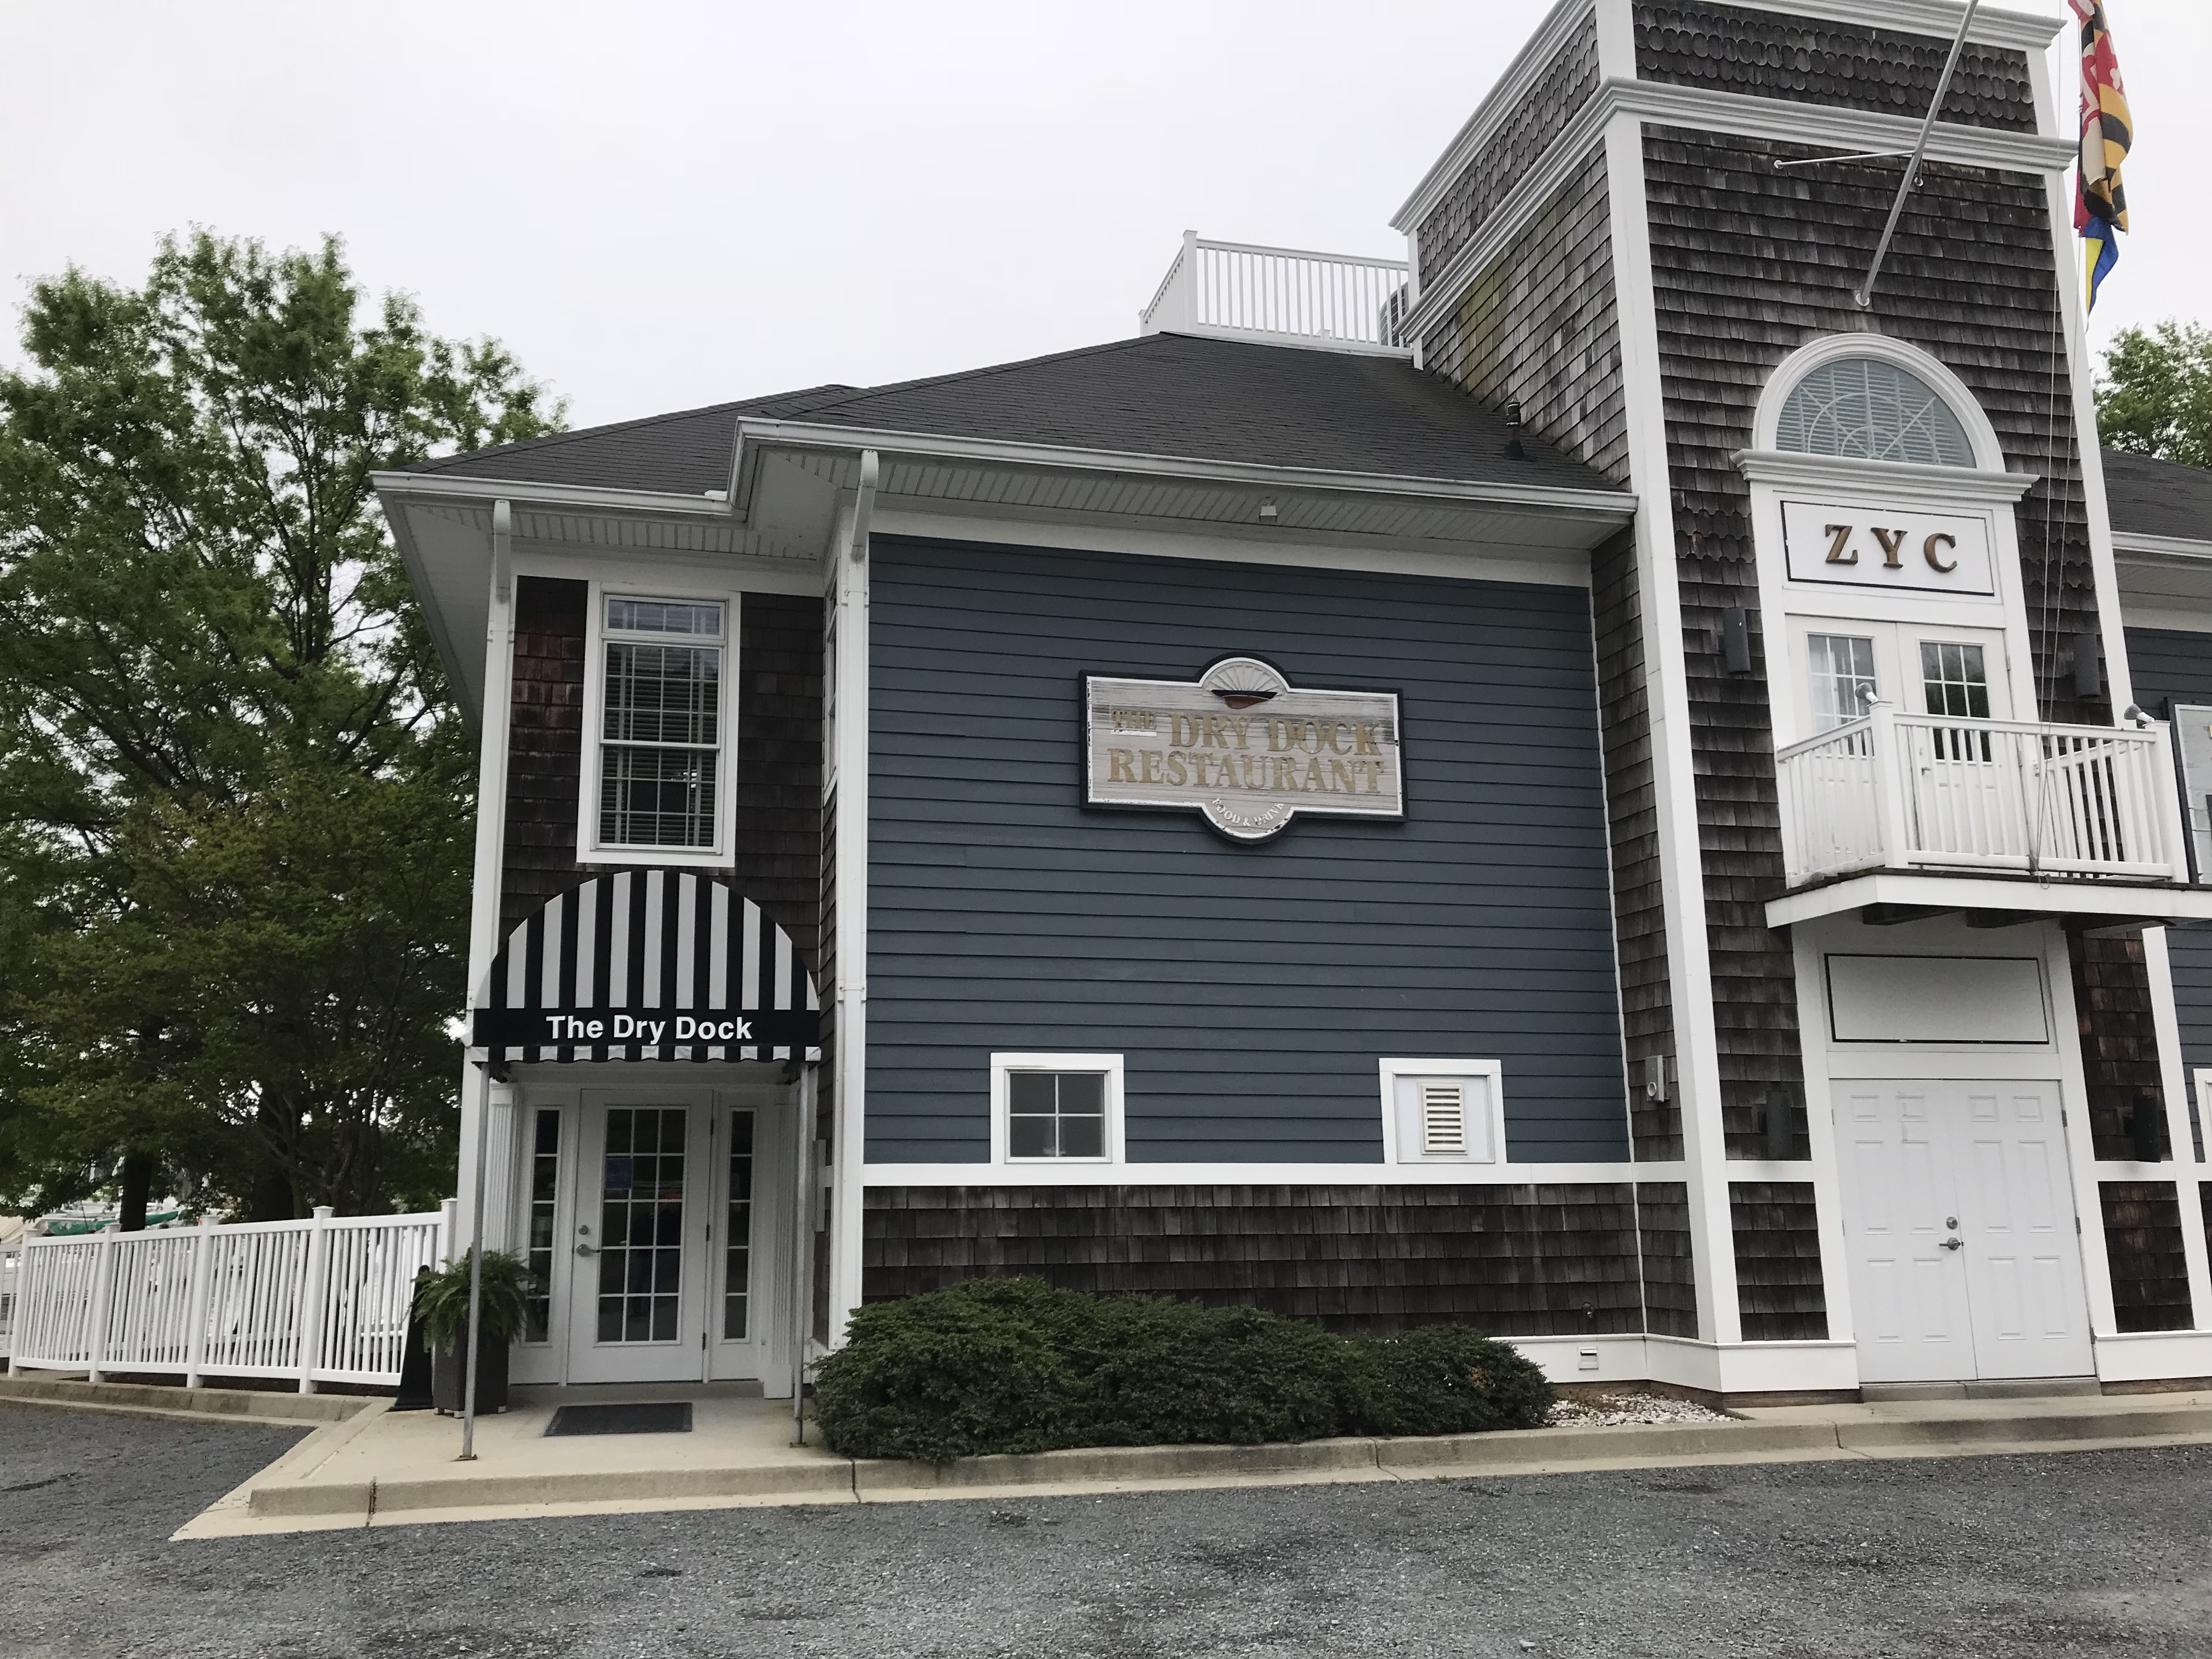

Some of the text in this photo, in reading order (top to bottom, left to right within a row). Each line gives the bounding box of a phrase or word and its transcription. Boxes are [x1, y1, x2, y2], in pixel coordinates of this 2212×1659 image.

[1825, 524, 1957, 573] ZYC
[1112, 710, 1382, 755] THE DRY DOCK
[1107, 748, 1384, 793] RESTAURANT
[1212, 797, 1240, 823] FOOD
[1243, 817, 1251, 826] &
[546, 1014, 752, 1045] The Dry Dock
